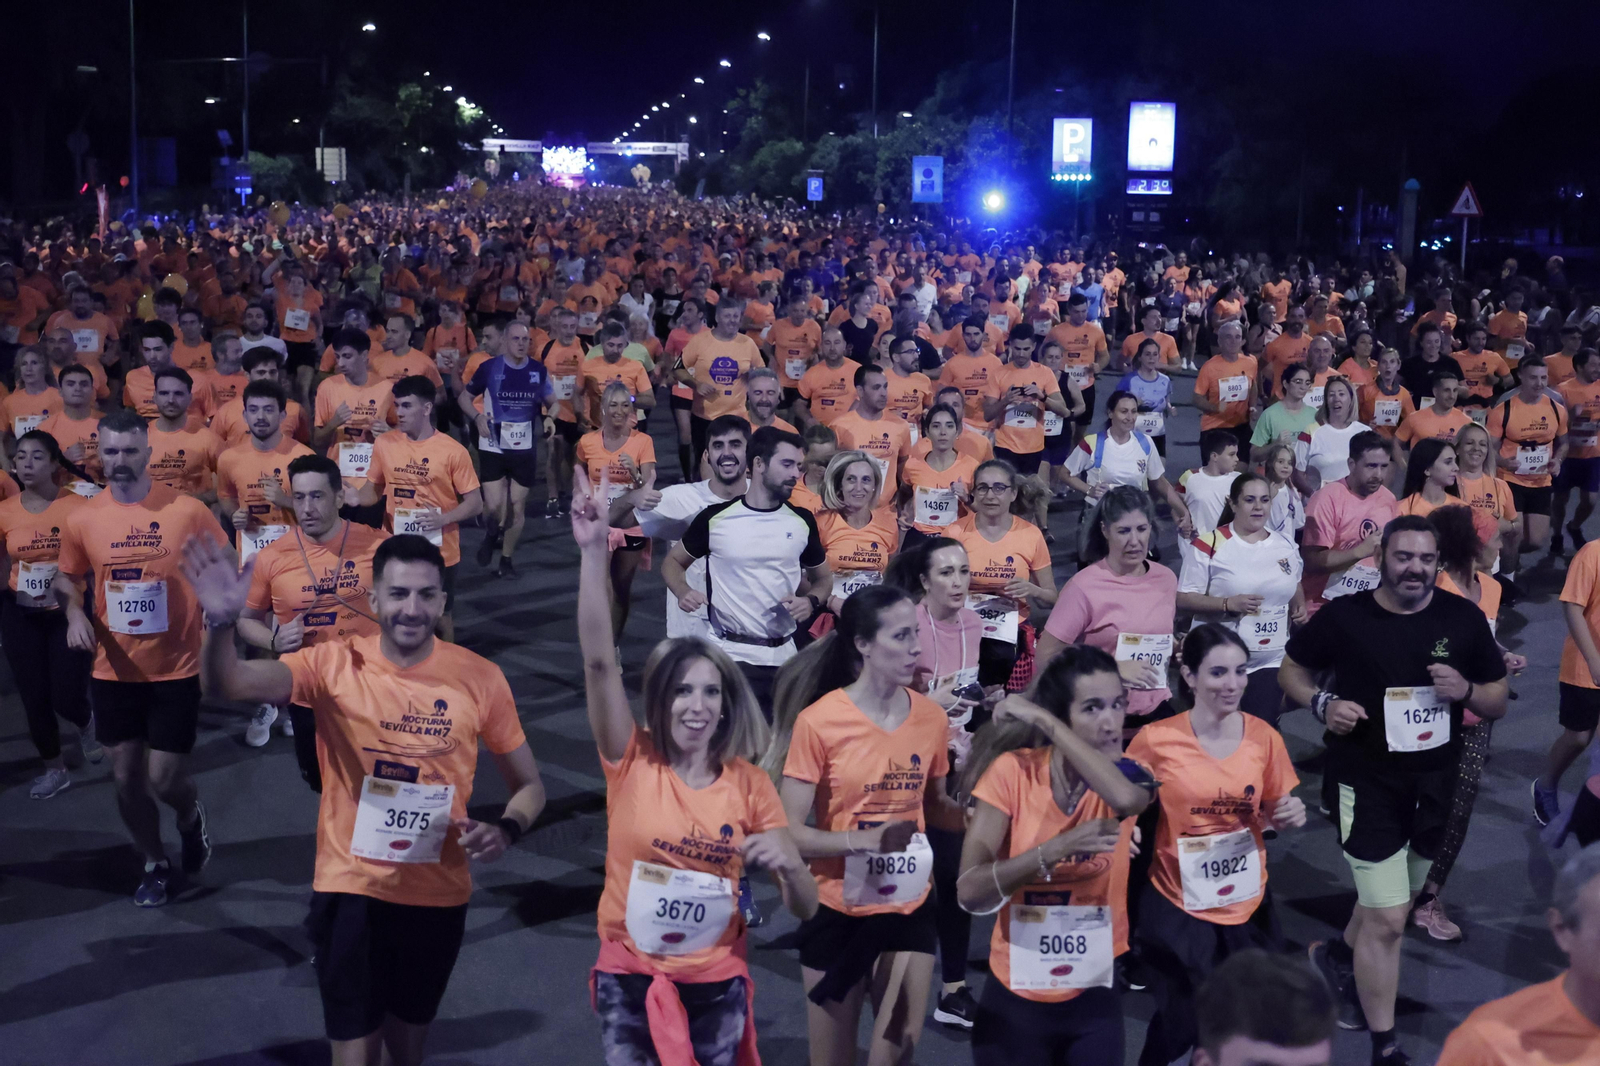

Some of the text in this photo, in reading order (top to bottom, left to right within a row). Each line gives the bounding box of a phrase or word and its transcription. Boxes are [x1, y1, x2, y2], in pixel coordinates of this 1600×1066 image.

[1063, 123, 1085, 155] P
[811, 180, 820, 190] P
[1143, 419, 1157, 427] 7243
[510, 431, 526, 439] 6134
[349, 454, 372, 463] 2088
[924, 500, 949, 511] 14367
[111, 541, 142, 549] SEVILLA
[838, 555, 865, 563] SEVILLA
[25, 578, 54, 590] 1618
[1341, 576, 1370, 591] 16188
[118, 600, 155, 613] 12780
[980, 608, 1006, 622] 9672
[1254, 621, 1278, 633] 3433
[401, 714, 453, 727] NOCTURNA
[1403, 705, 1444, 724] 16271
[379, 720, 422, 735] SEVILLA
[384, 808, 430, 831] 3675
[651, 837, 704, 861] SEVILLA
[866, 856, 917, 875] 19826
[1201, 854, 1248, 879] 19822
[655, 897, 706, 923] 3670
[1039, 935, 1087, 955] 5068
